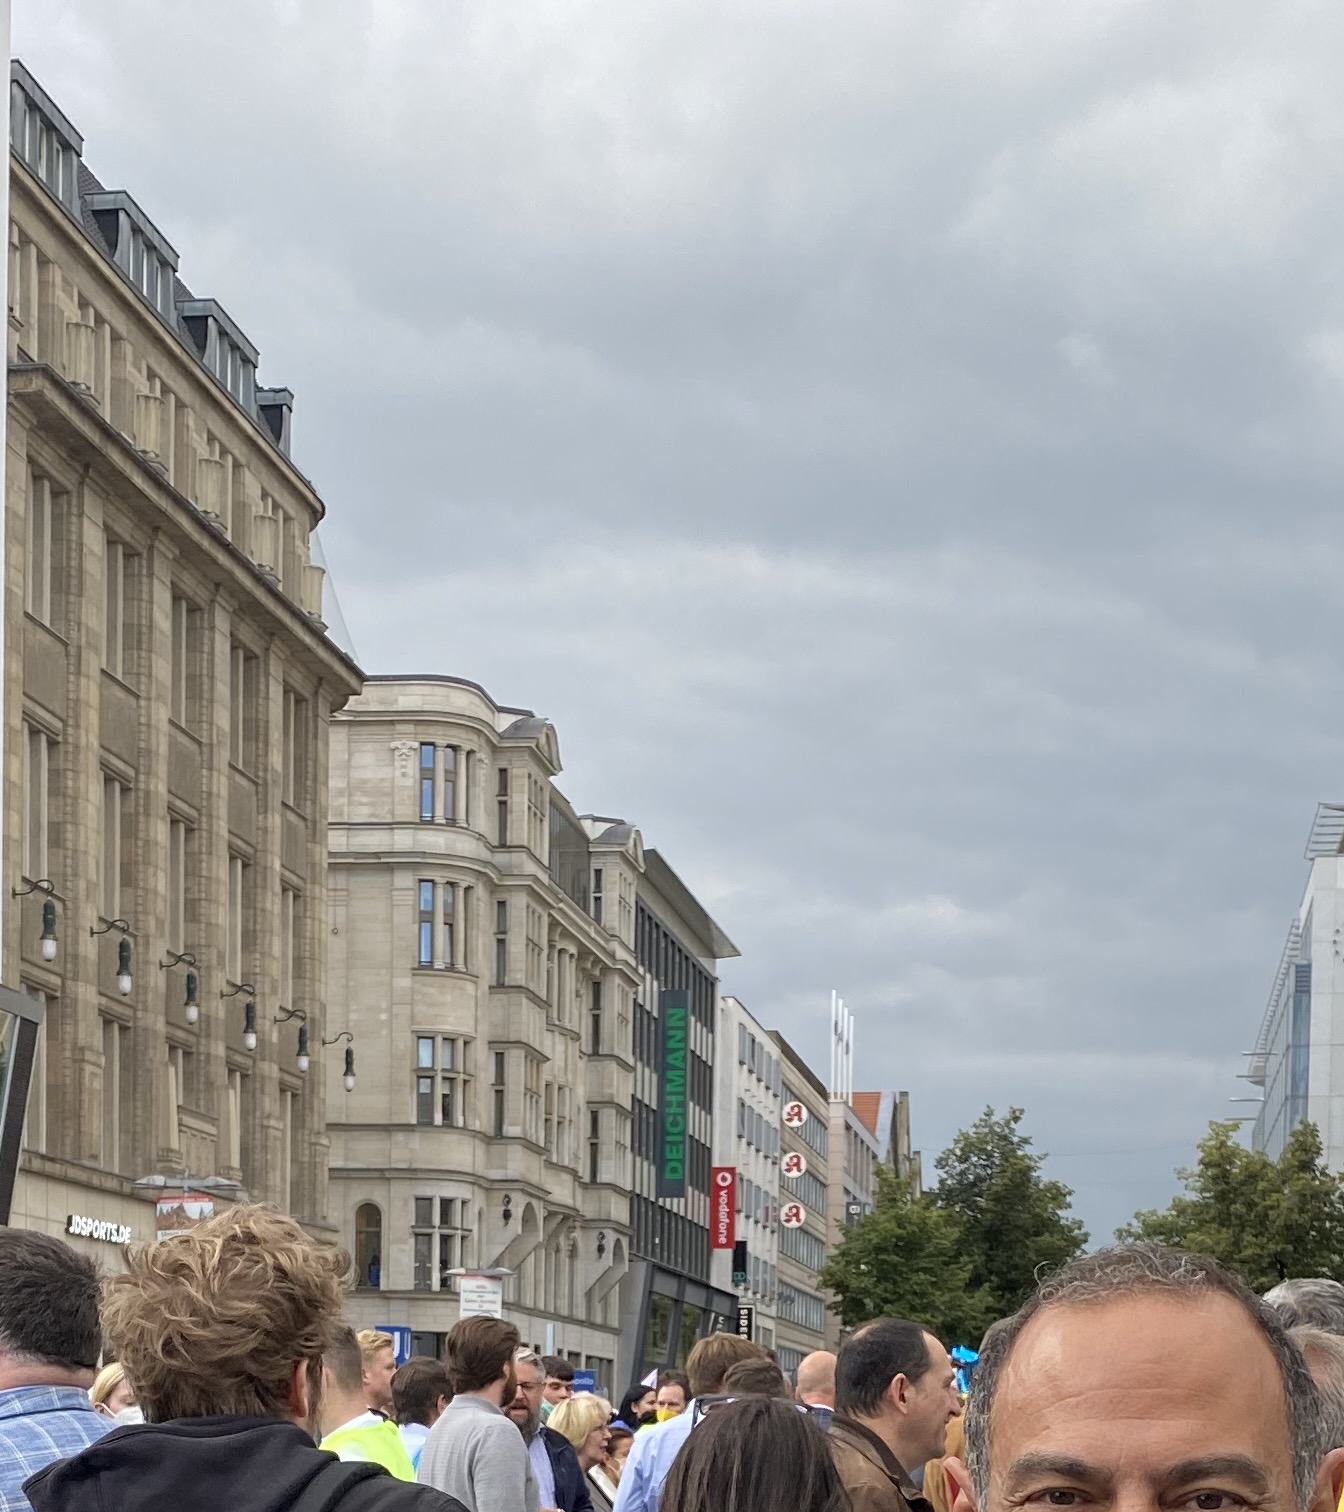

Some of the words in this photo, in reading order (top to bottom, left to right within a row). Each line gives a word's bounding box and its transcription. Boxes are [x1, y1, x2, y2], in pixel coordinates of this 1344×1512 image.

[664, 1007, 686, 1180] DEICHMANN
[68, 1214, 132, 1244] JDSPORTS.DE
[718, 1189, 730, 1245] vodafone
